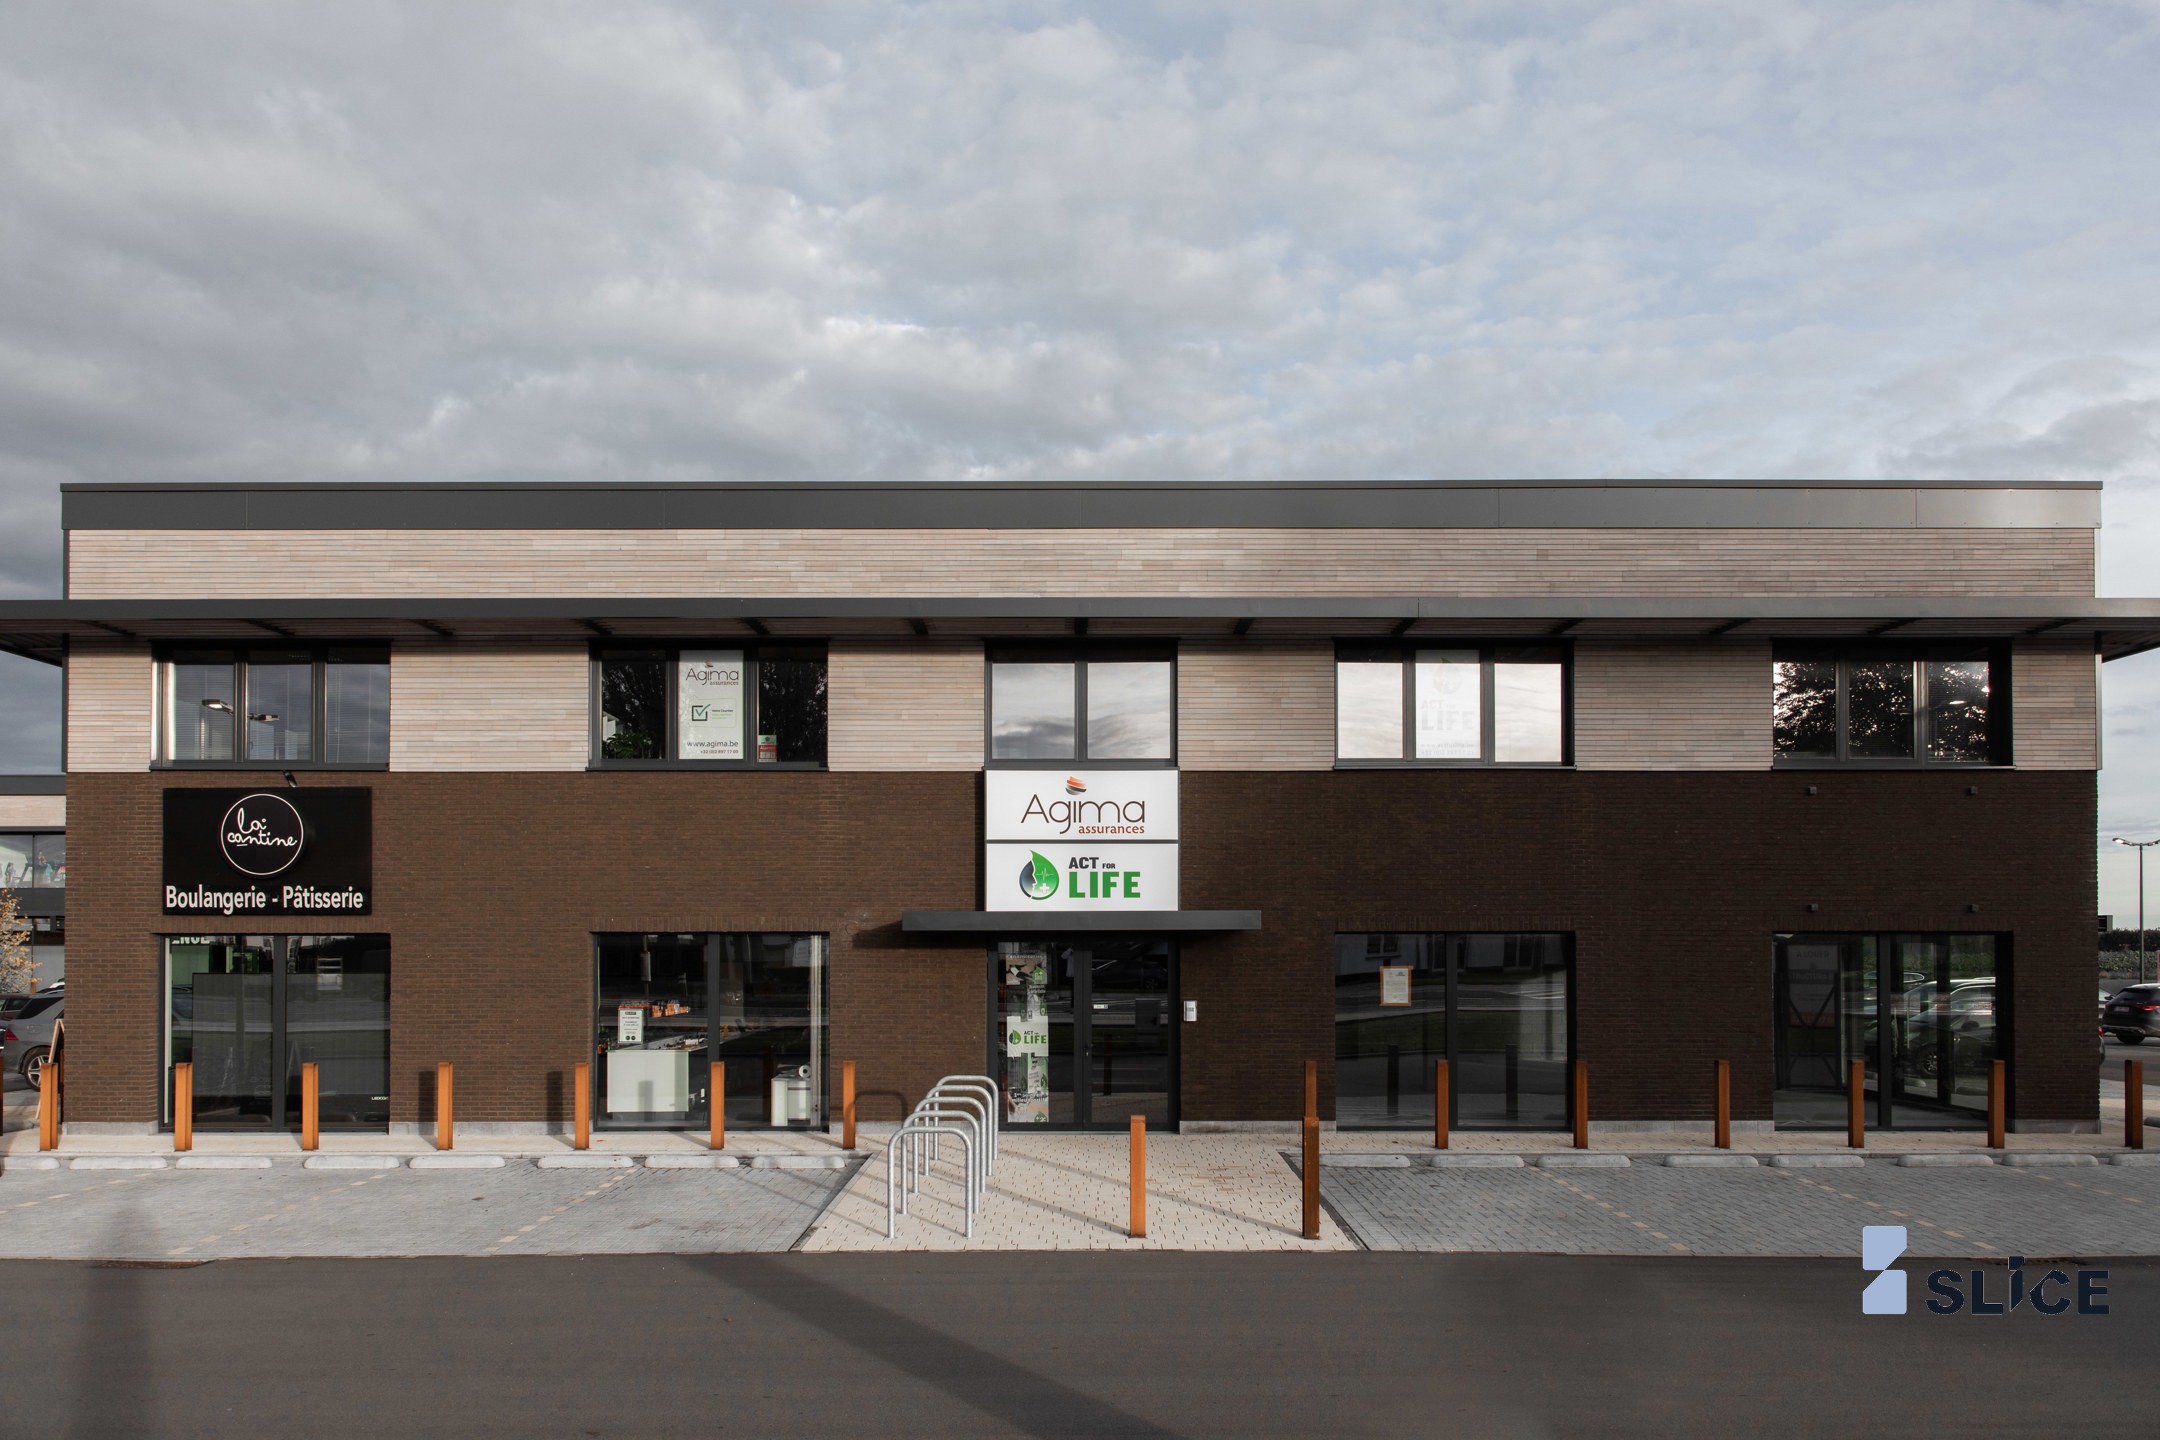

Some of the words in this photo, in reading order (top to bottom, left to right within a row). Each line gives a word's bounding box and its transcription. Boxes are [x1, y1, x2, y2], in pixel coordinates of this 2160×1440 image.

[686, 668, 739, 686] Agima
[1421, 710, 1476, 731] LIFE
[686, 740, 739, 748] www.agima.be
[1020, 793, 1145, 835] Agima
[227, 829, 298, 847] cantine
[1078, 824, 1145, 834] assurances
[1068, 856, 1099, 869] ACT
[1069, 871, 1141, 898] LIFE
[165, 884, 266, 915] Boulangerie
[282, 885, 364, 909] Pâtisserie
[1023, 1035, 1047, 1044] LIFE
